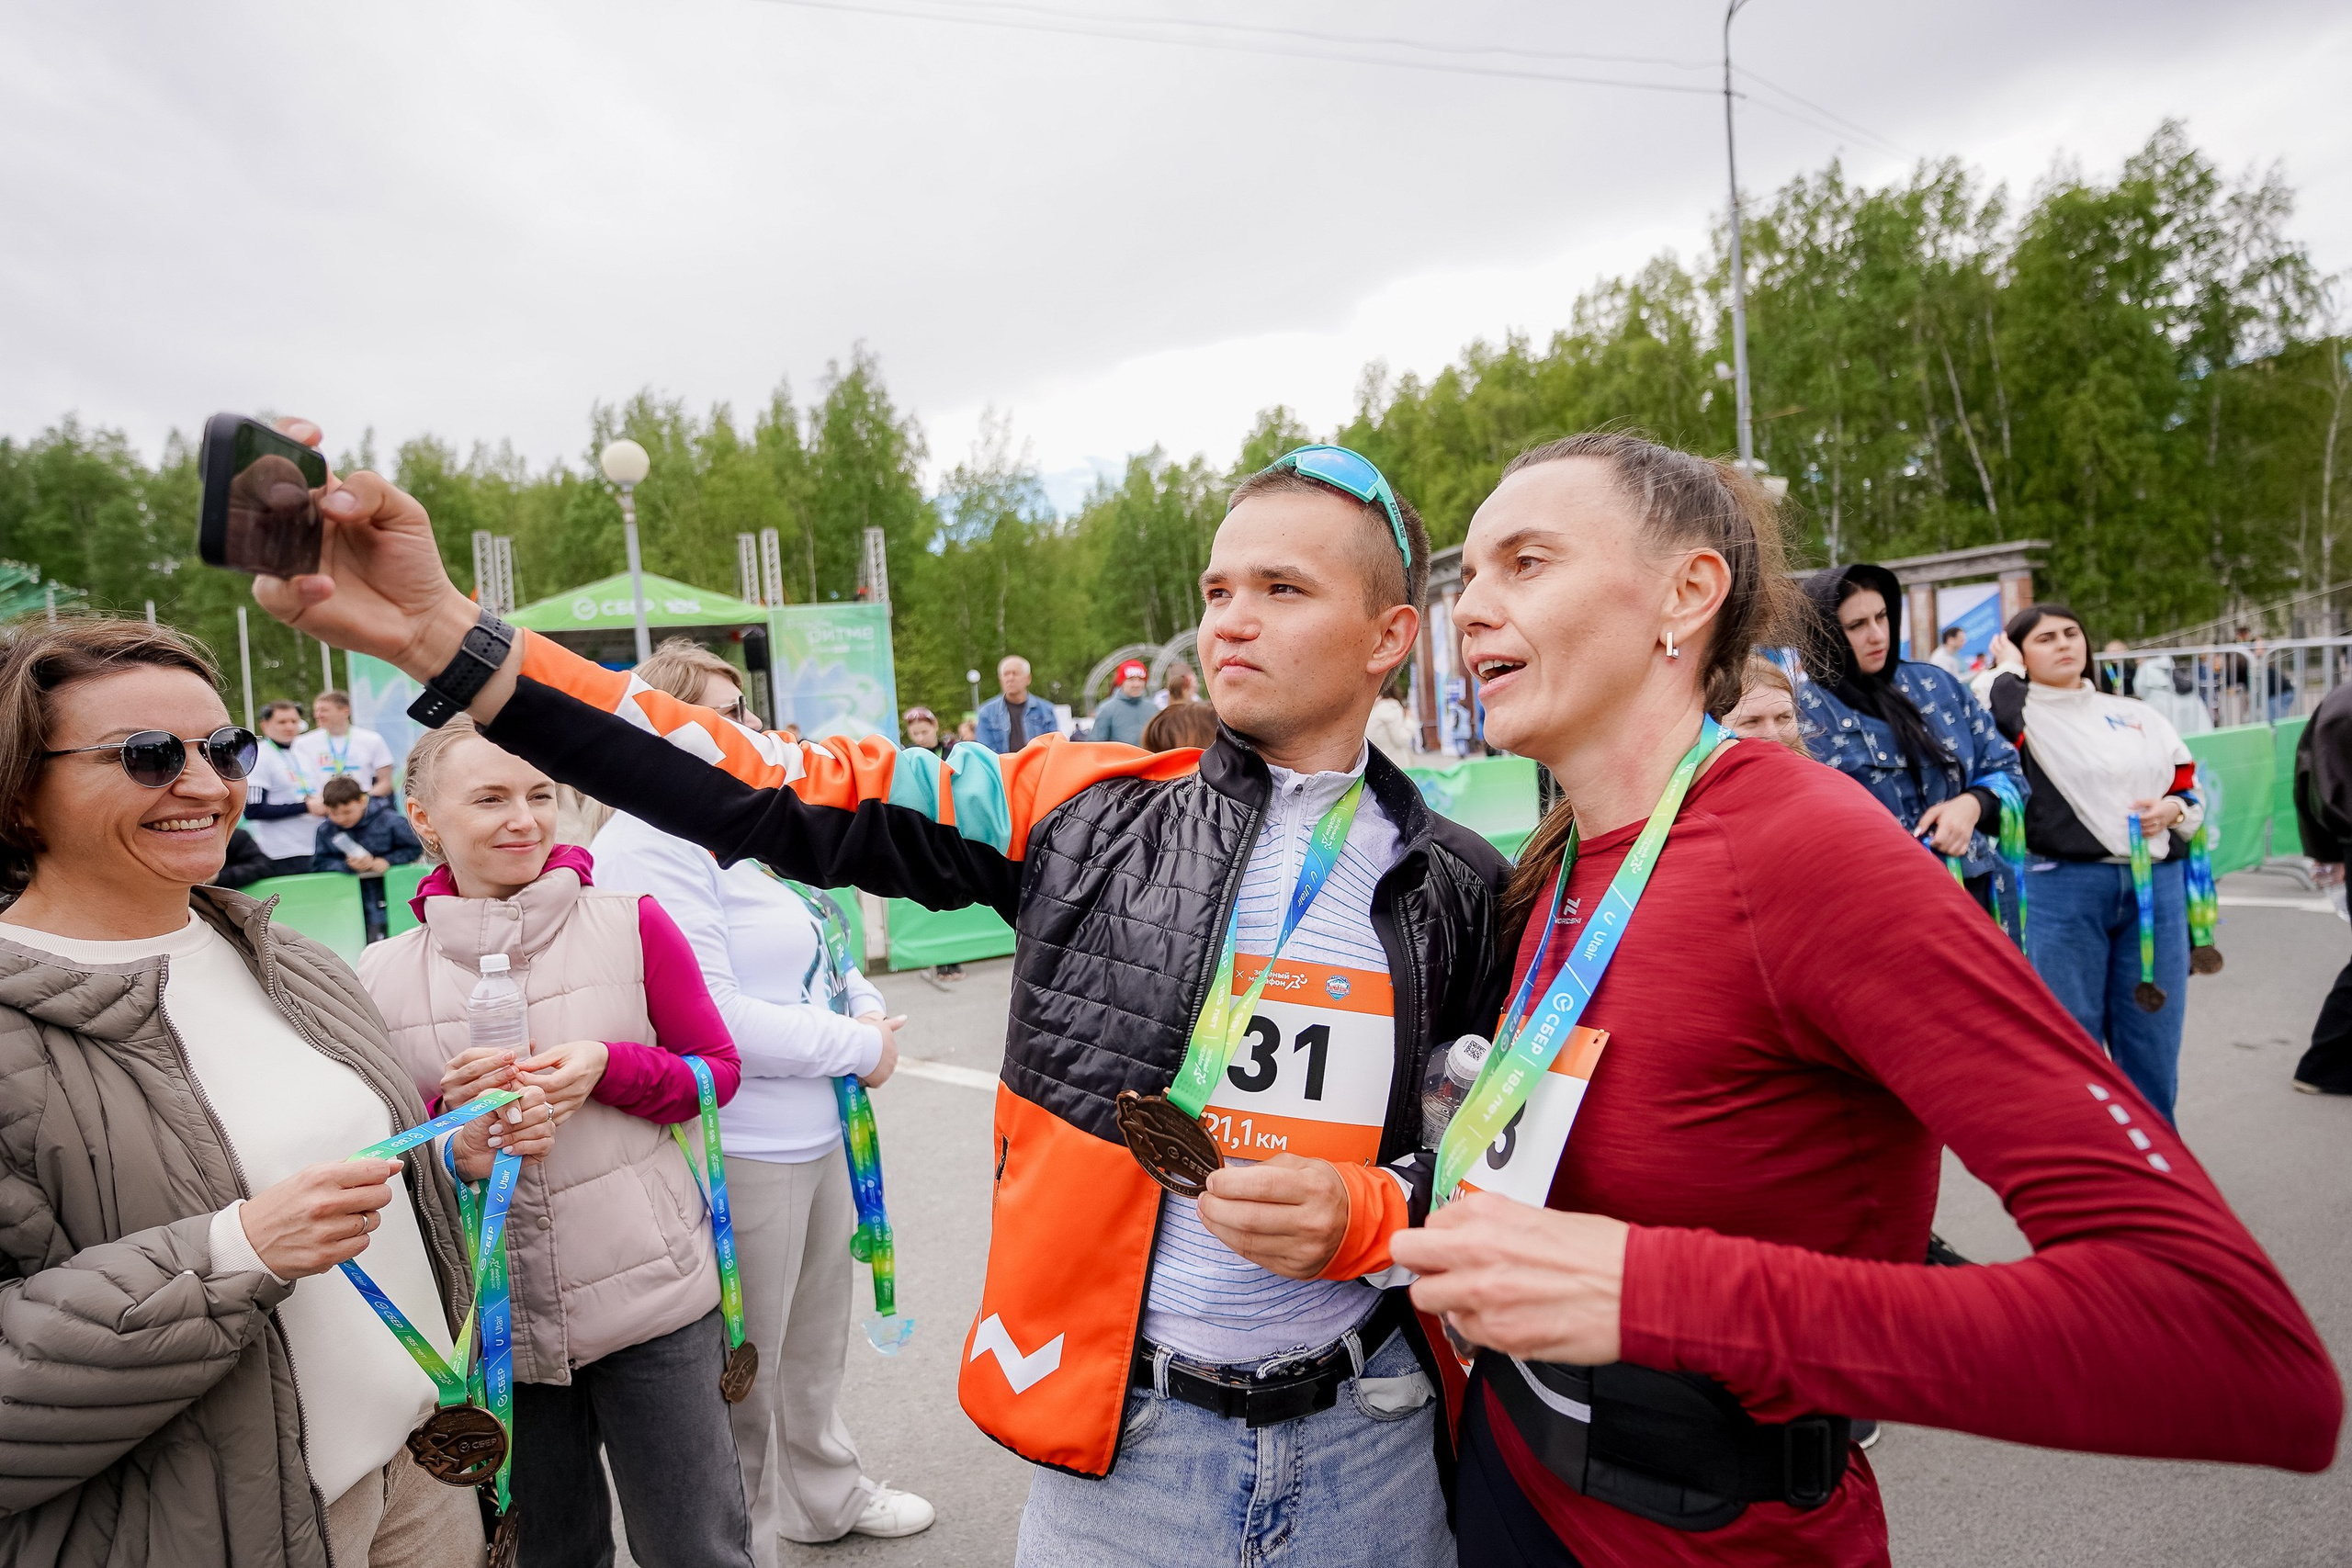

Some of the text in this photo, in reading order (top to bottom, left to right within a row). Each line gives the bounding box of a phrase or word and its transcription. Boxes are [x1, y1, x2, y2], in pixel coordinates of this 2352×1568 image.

[1297, 884, 1314, 908] Utair
[1583, 931, 1608, 962] Utair
[1531, 1013, 1560, 1055] СБЕР
[1227, 1014, 1331, 1101] 31
[701, 1073, 711, 1095] СБЕР
[1501, 1069, 1526, 1096] 185
[1481, 1093, 1505, 1123] лет
[1206, 1112, 1253, 1150] 21,1
[1255, 1132, 1288, 1151] км
[459, 1182, 469, 1201] БЕР
[499, 1169, 511, 1190] Utair
[484, 1225, 495, 1257] СБЕР
[384, 1310, 404, 1328] СБЕР
[495, 1315, 503, 1335] Utair
[497, 1368, 506, 1393] СБЕР
[471, 1437, 498, 1450] СБЕР
